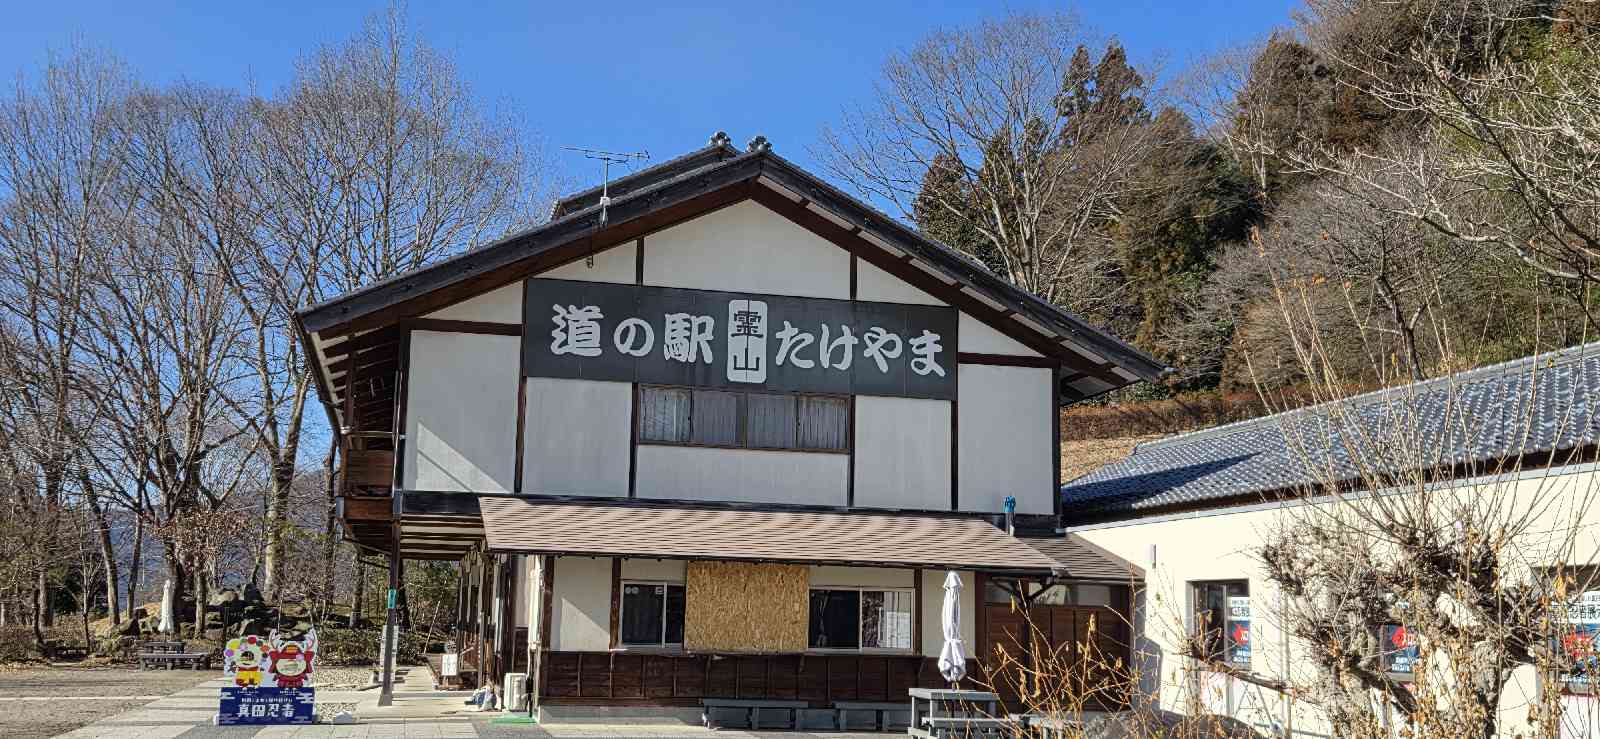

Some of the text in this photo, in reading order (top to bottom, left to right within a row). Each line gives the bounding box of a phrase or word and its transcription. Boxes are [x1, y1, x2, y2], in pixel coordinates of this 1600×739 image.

[551, 303, 715, 364] 道の駅
[732, 309, 764, 374] 霊山
[775, 320, 947, 378] たけやま
